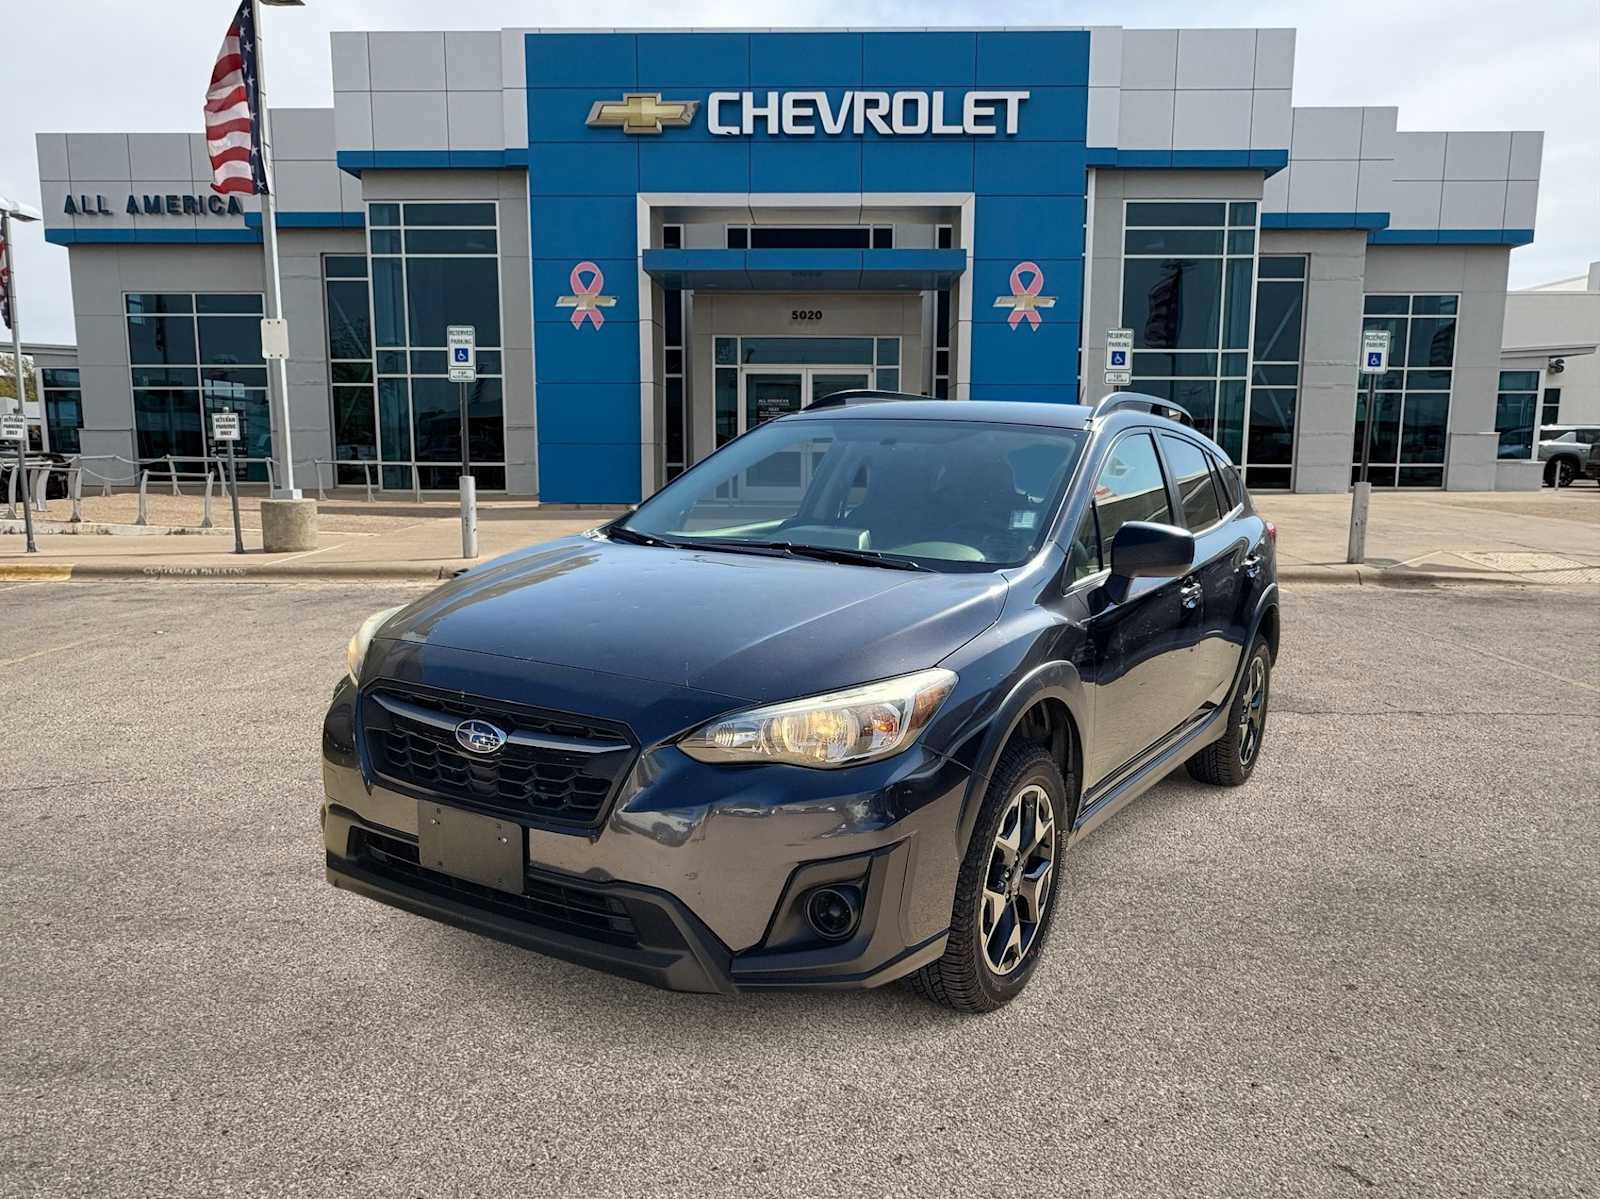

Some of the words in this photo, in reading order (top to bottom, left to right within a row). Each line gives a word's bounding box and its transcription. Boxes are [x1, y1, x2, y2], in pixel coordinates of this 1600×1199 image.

[707, 90, 1031, 136] CHEVROLET
[63, 194, 112, 216] ALL
[126, 194, 244, 216] AMERICA
[791, 310, 822, 321] 5020
